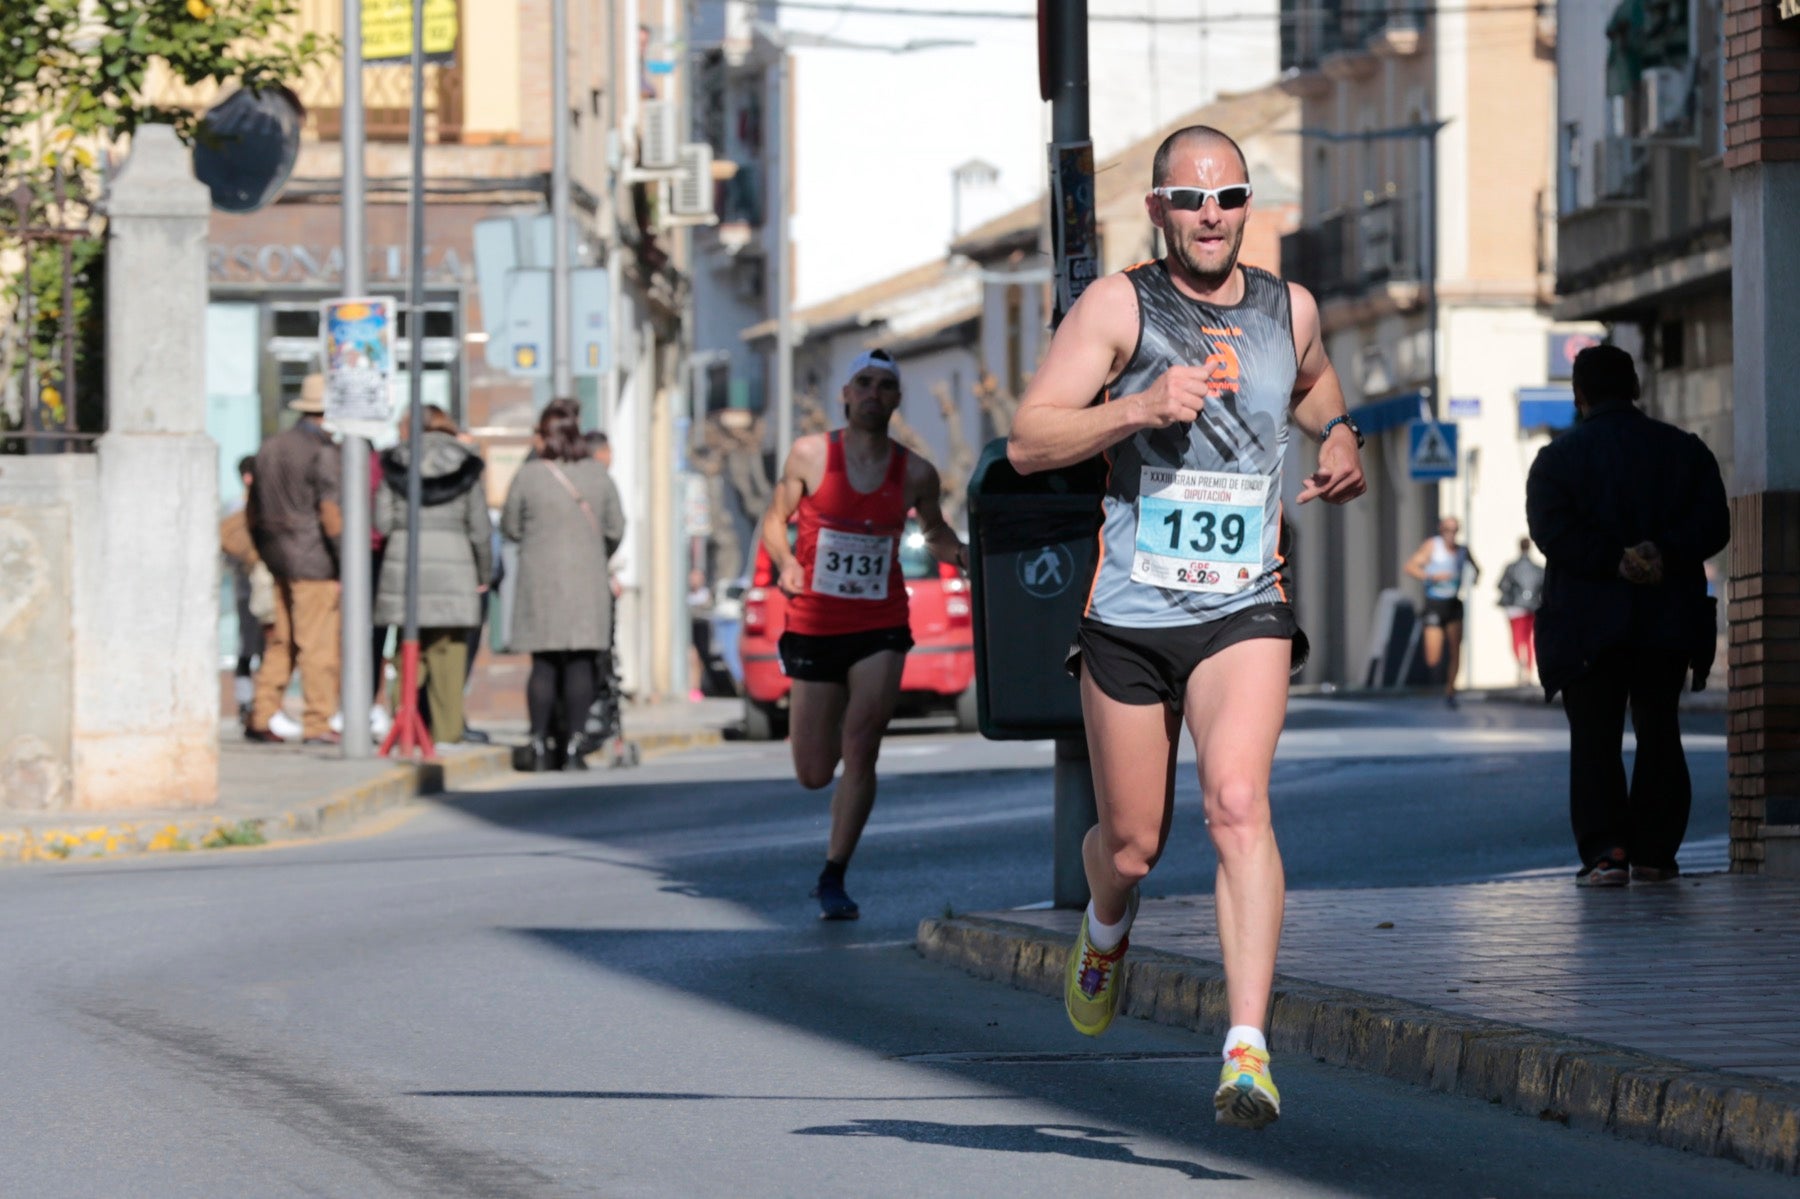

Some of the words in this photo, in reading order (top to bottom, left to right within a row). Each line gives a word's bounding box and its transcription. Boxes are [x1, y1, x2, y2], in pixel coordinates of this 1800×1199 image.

[1175, 474, 1196, 487] GRAN
[1198, 476, 1227, 489] PREMIO
[1229, 478, 1239, 489] DE
[1240, 479, 1264, 492] FONDO
[1184, 489, 1231, 502] DIPUTACIÓN
[1163, 509, 1245, 555] 139
[826, 551, 883, 576] 3131
